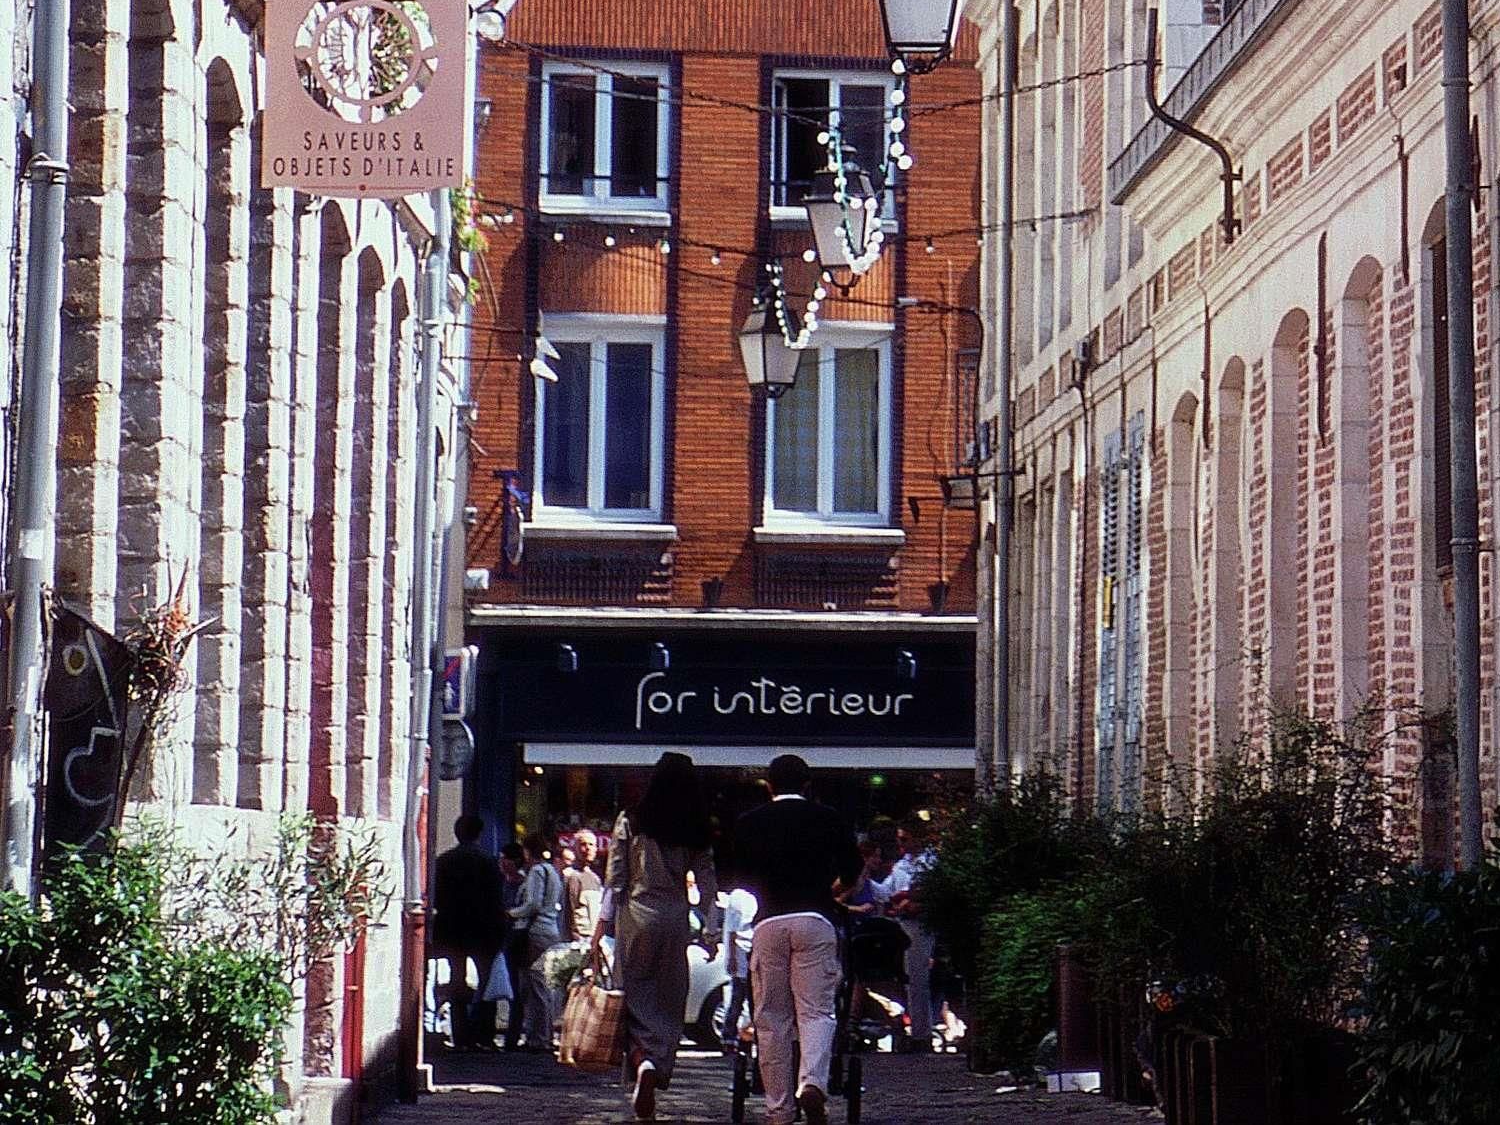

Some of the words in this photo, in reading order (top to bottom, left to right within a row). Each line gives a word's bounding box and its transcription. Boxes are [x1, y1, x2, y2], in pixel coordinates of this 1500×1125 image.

[304, 132, 402, 151] SAVEURS
[415, 132, 425, 151] &
[273, 157, 352, 177] OBJETS
[363, 158, 455, 177] D'ITALIE
